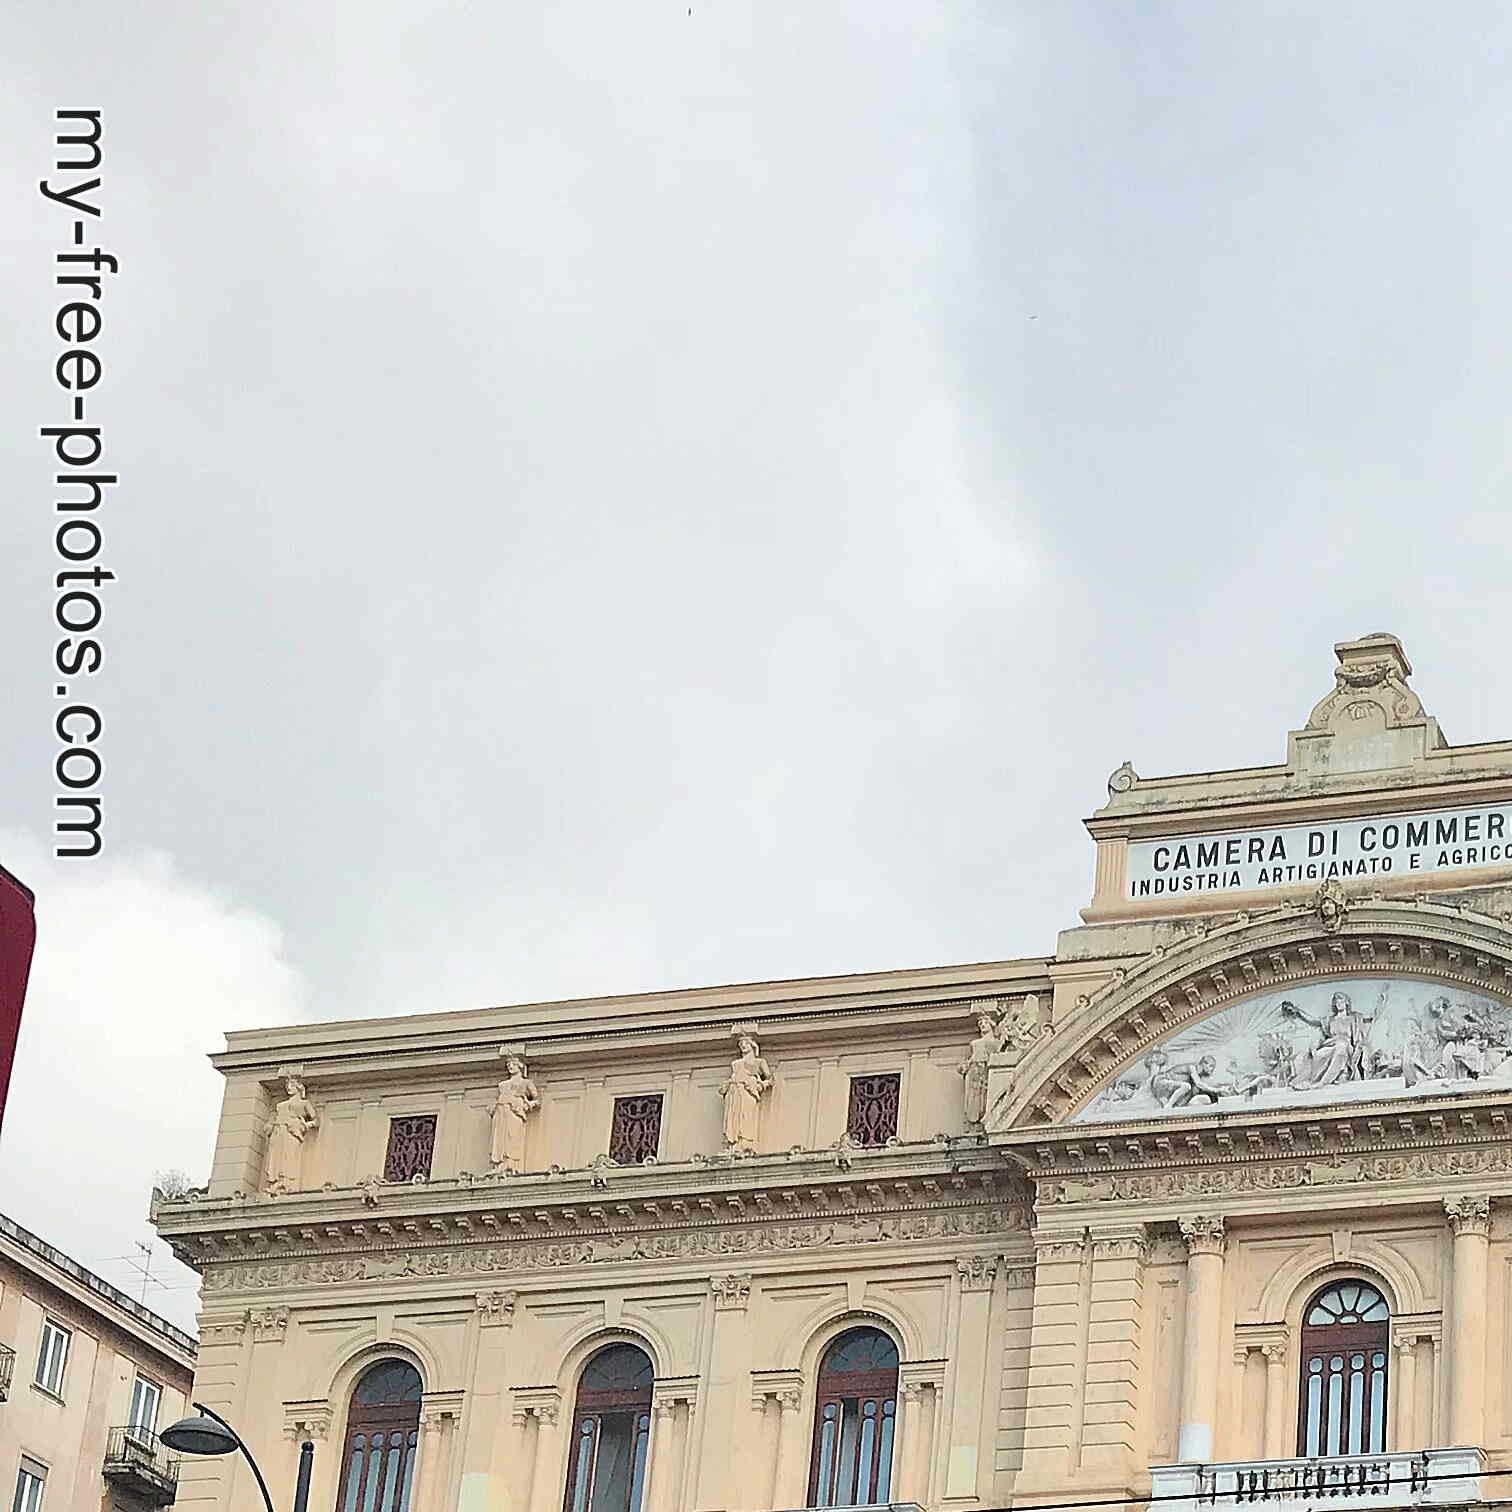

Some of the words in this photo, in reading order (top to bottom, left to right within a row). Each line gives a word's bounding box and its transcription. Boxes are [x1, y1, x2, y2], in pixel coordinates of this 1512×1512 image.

[1153, 835, 1287, 872] CAMERA
[1308, 830, 1338, 857] DI
[1131, 870, 1241, 896] INDUSTRIA
[1258, 856, 1392, 885] ARTIGIANATO
[1410, 854, 1420, 869] E
